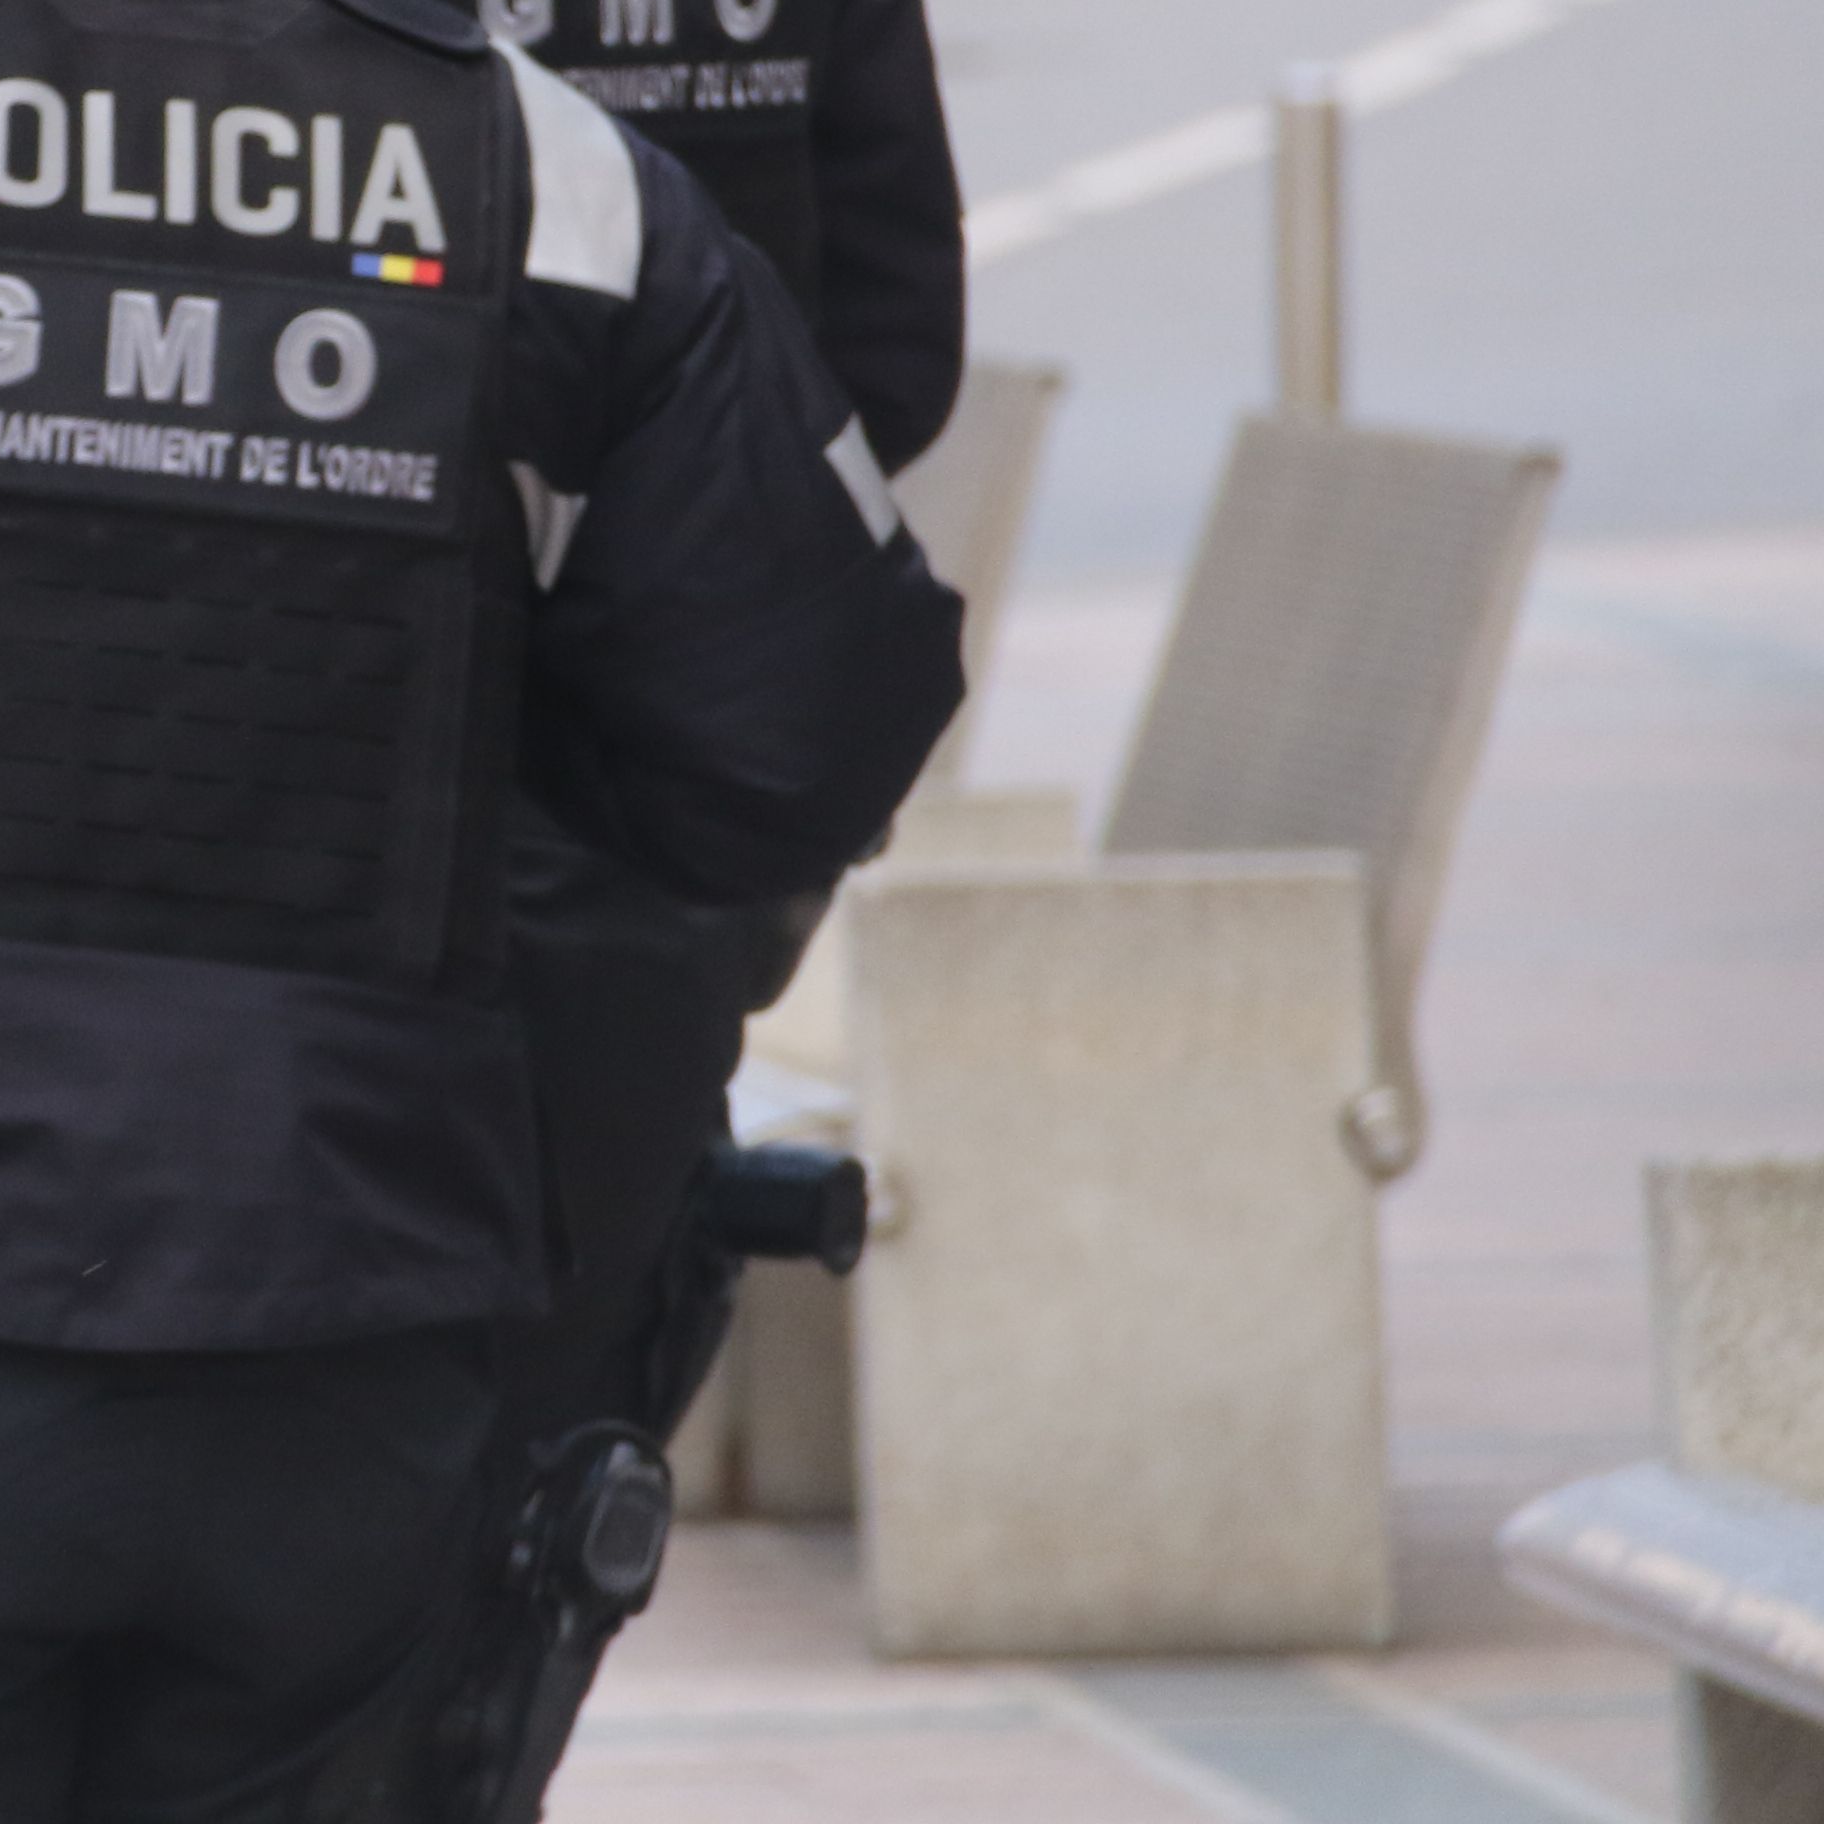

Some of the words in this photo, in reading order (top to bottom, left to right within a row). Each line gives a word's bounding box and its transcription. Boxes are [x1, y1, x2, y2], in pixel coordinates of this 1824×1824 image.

[104, 288, 220, 407] M
[273, 307, 378, 421] O
[238, 436, 289, 485] DE
[295, 443, 439, 502] L'ORDRE
